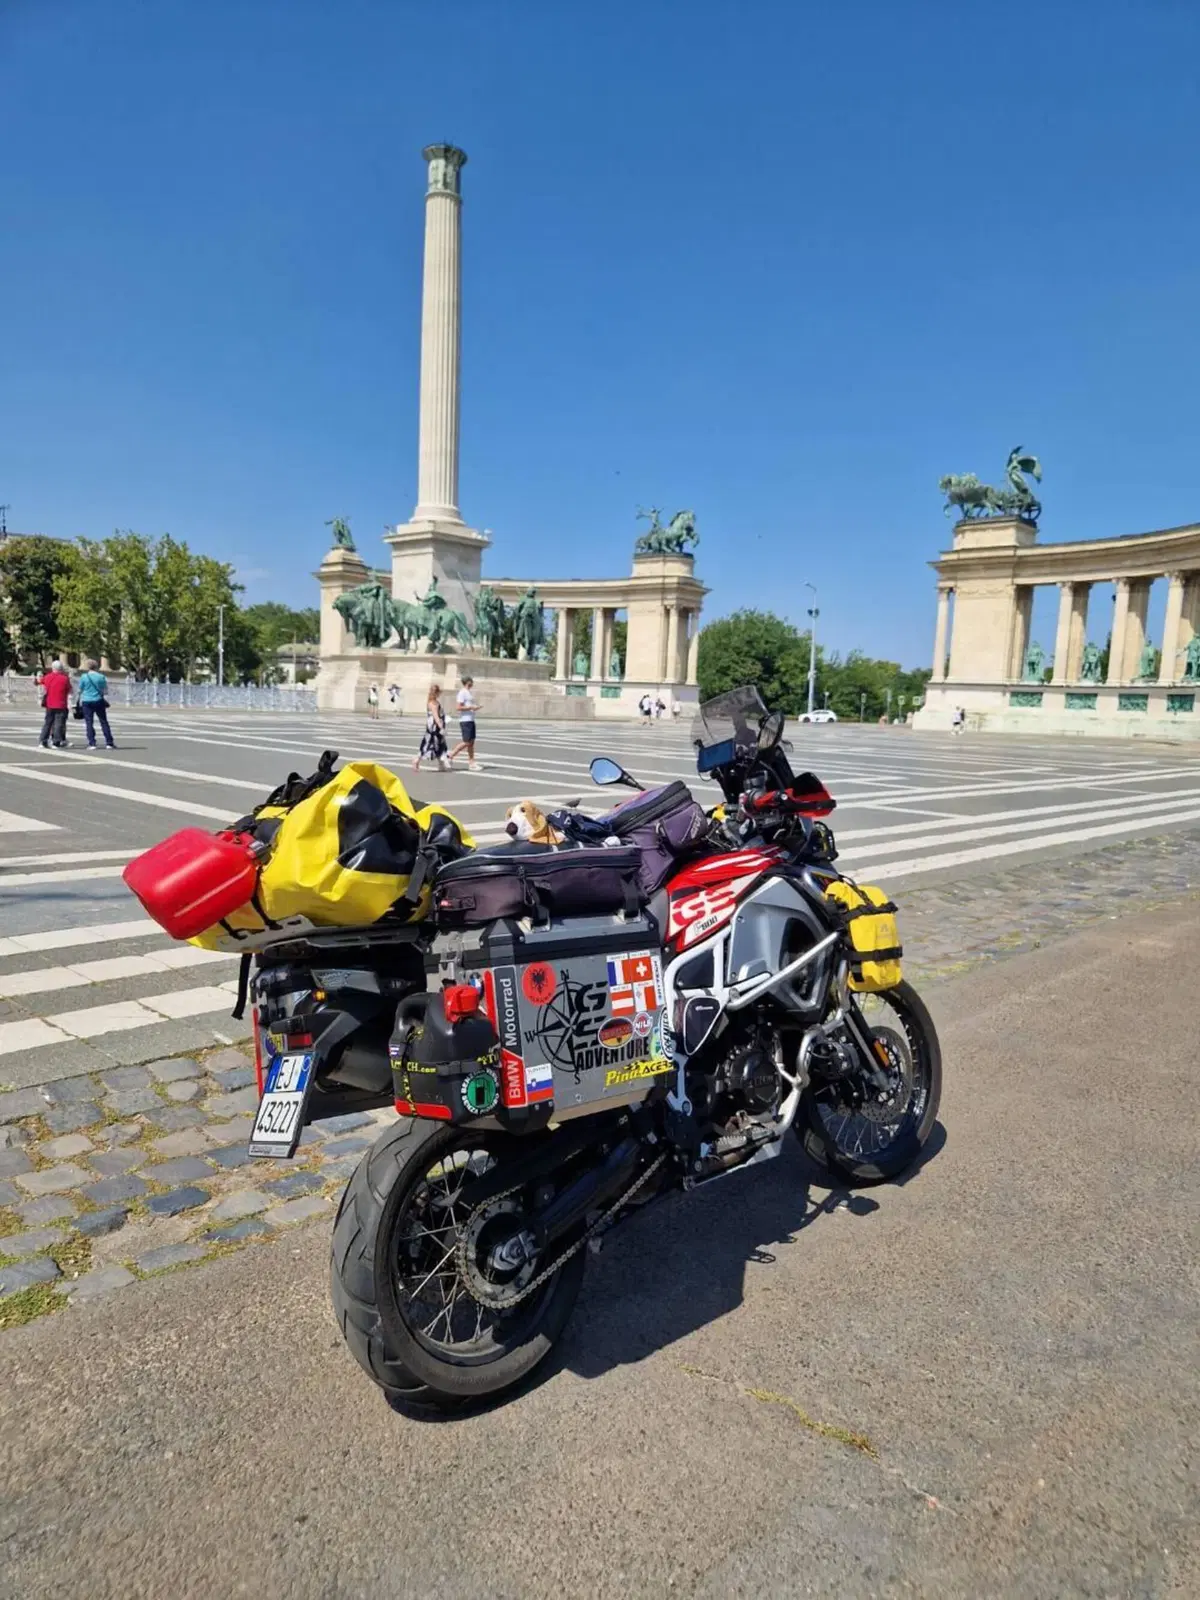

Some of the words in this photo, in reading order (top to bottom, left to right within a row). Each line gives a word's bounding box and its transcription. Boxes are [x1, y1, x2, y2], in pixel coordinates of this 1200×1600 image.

[672, 880, 737, 927] GS
[501, 977, 518, 1046] Motorrad
[575, 1036, 651, 1072] ADVENTURE
[275, 1058, 297, 1090] EJ
[508, 1060, 522, 1099] BMW
[256, 1100, 300, 1134] 43227
